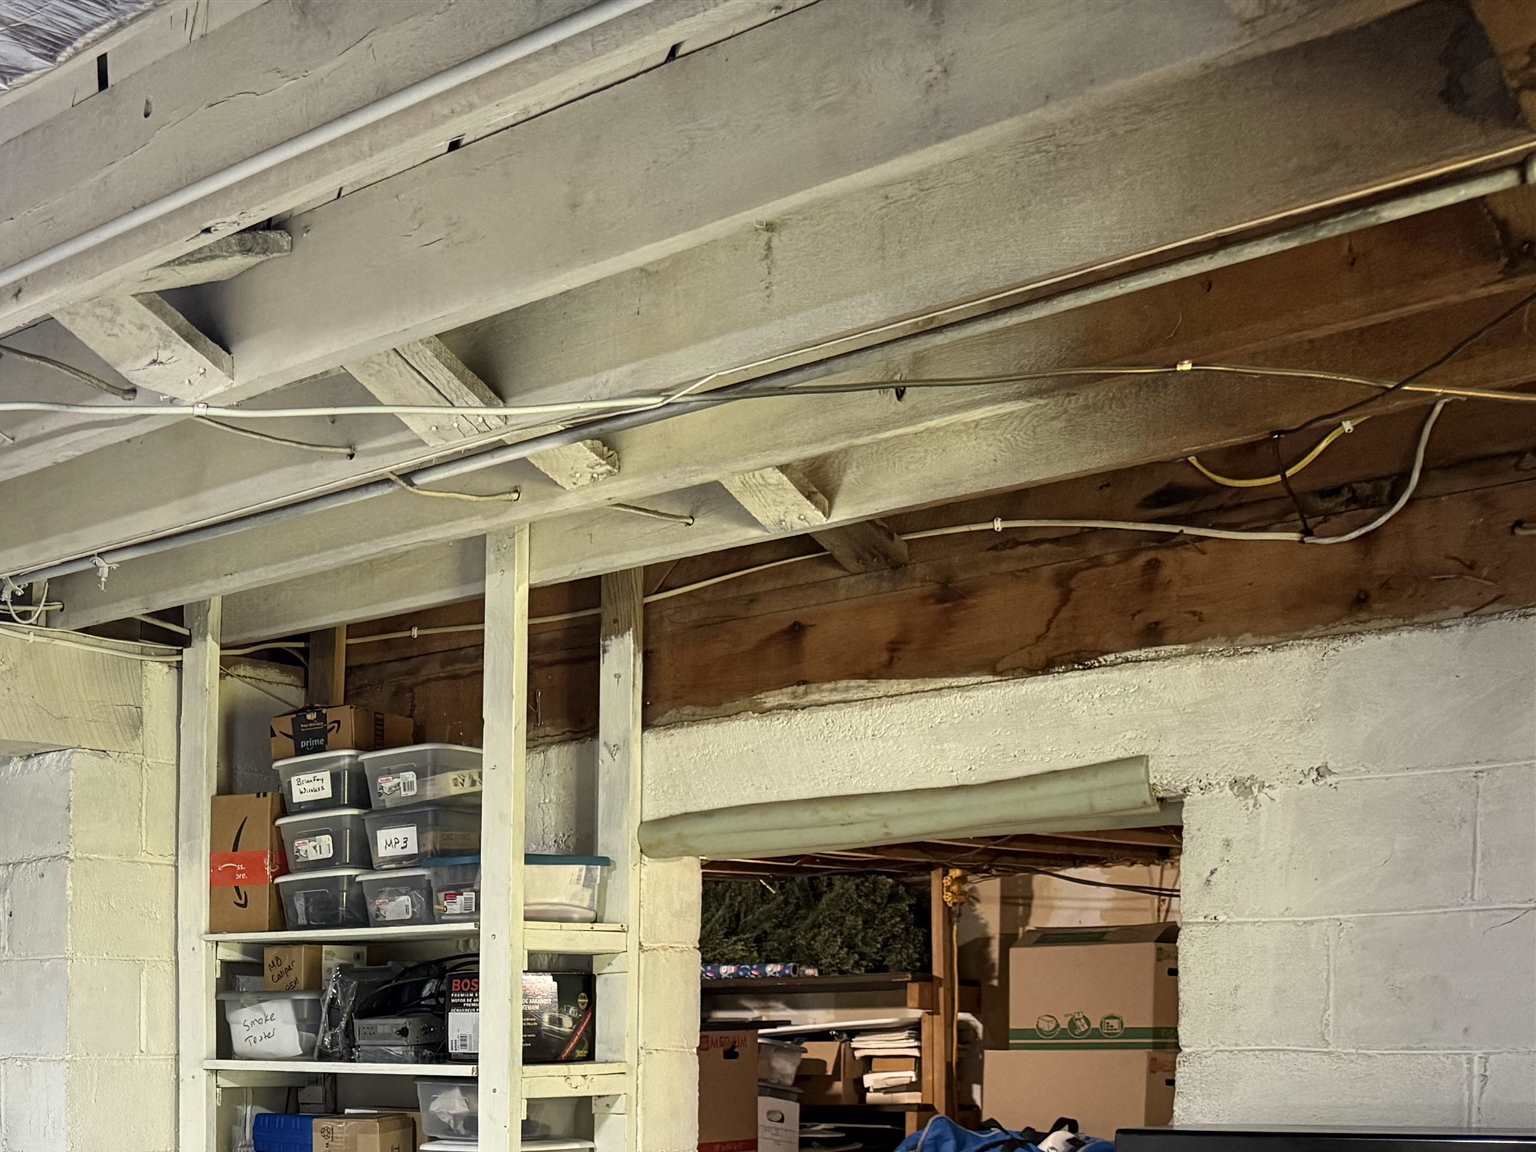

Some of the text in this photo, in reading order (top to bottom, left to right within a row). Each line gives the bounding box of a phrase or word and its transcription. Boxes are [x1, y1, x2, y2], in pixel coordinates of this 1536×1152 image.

[300, 737, 325, 748] prime
[384, 837, 409, 850] MP3
[243, 1012, 276, 1032] Smoke
